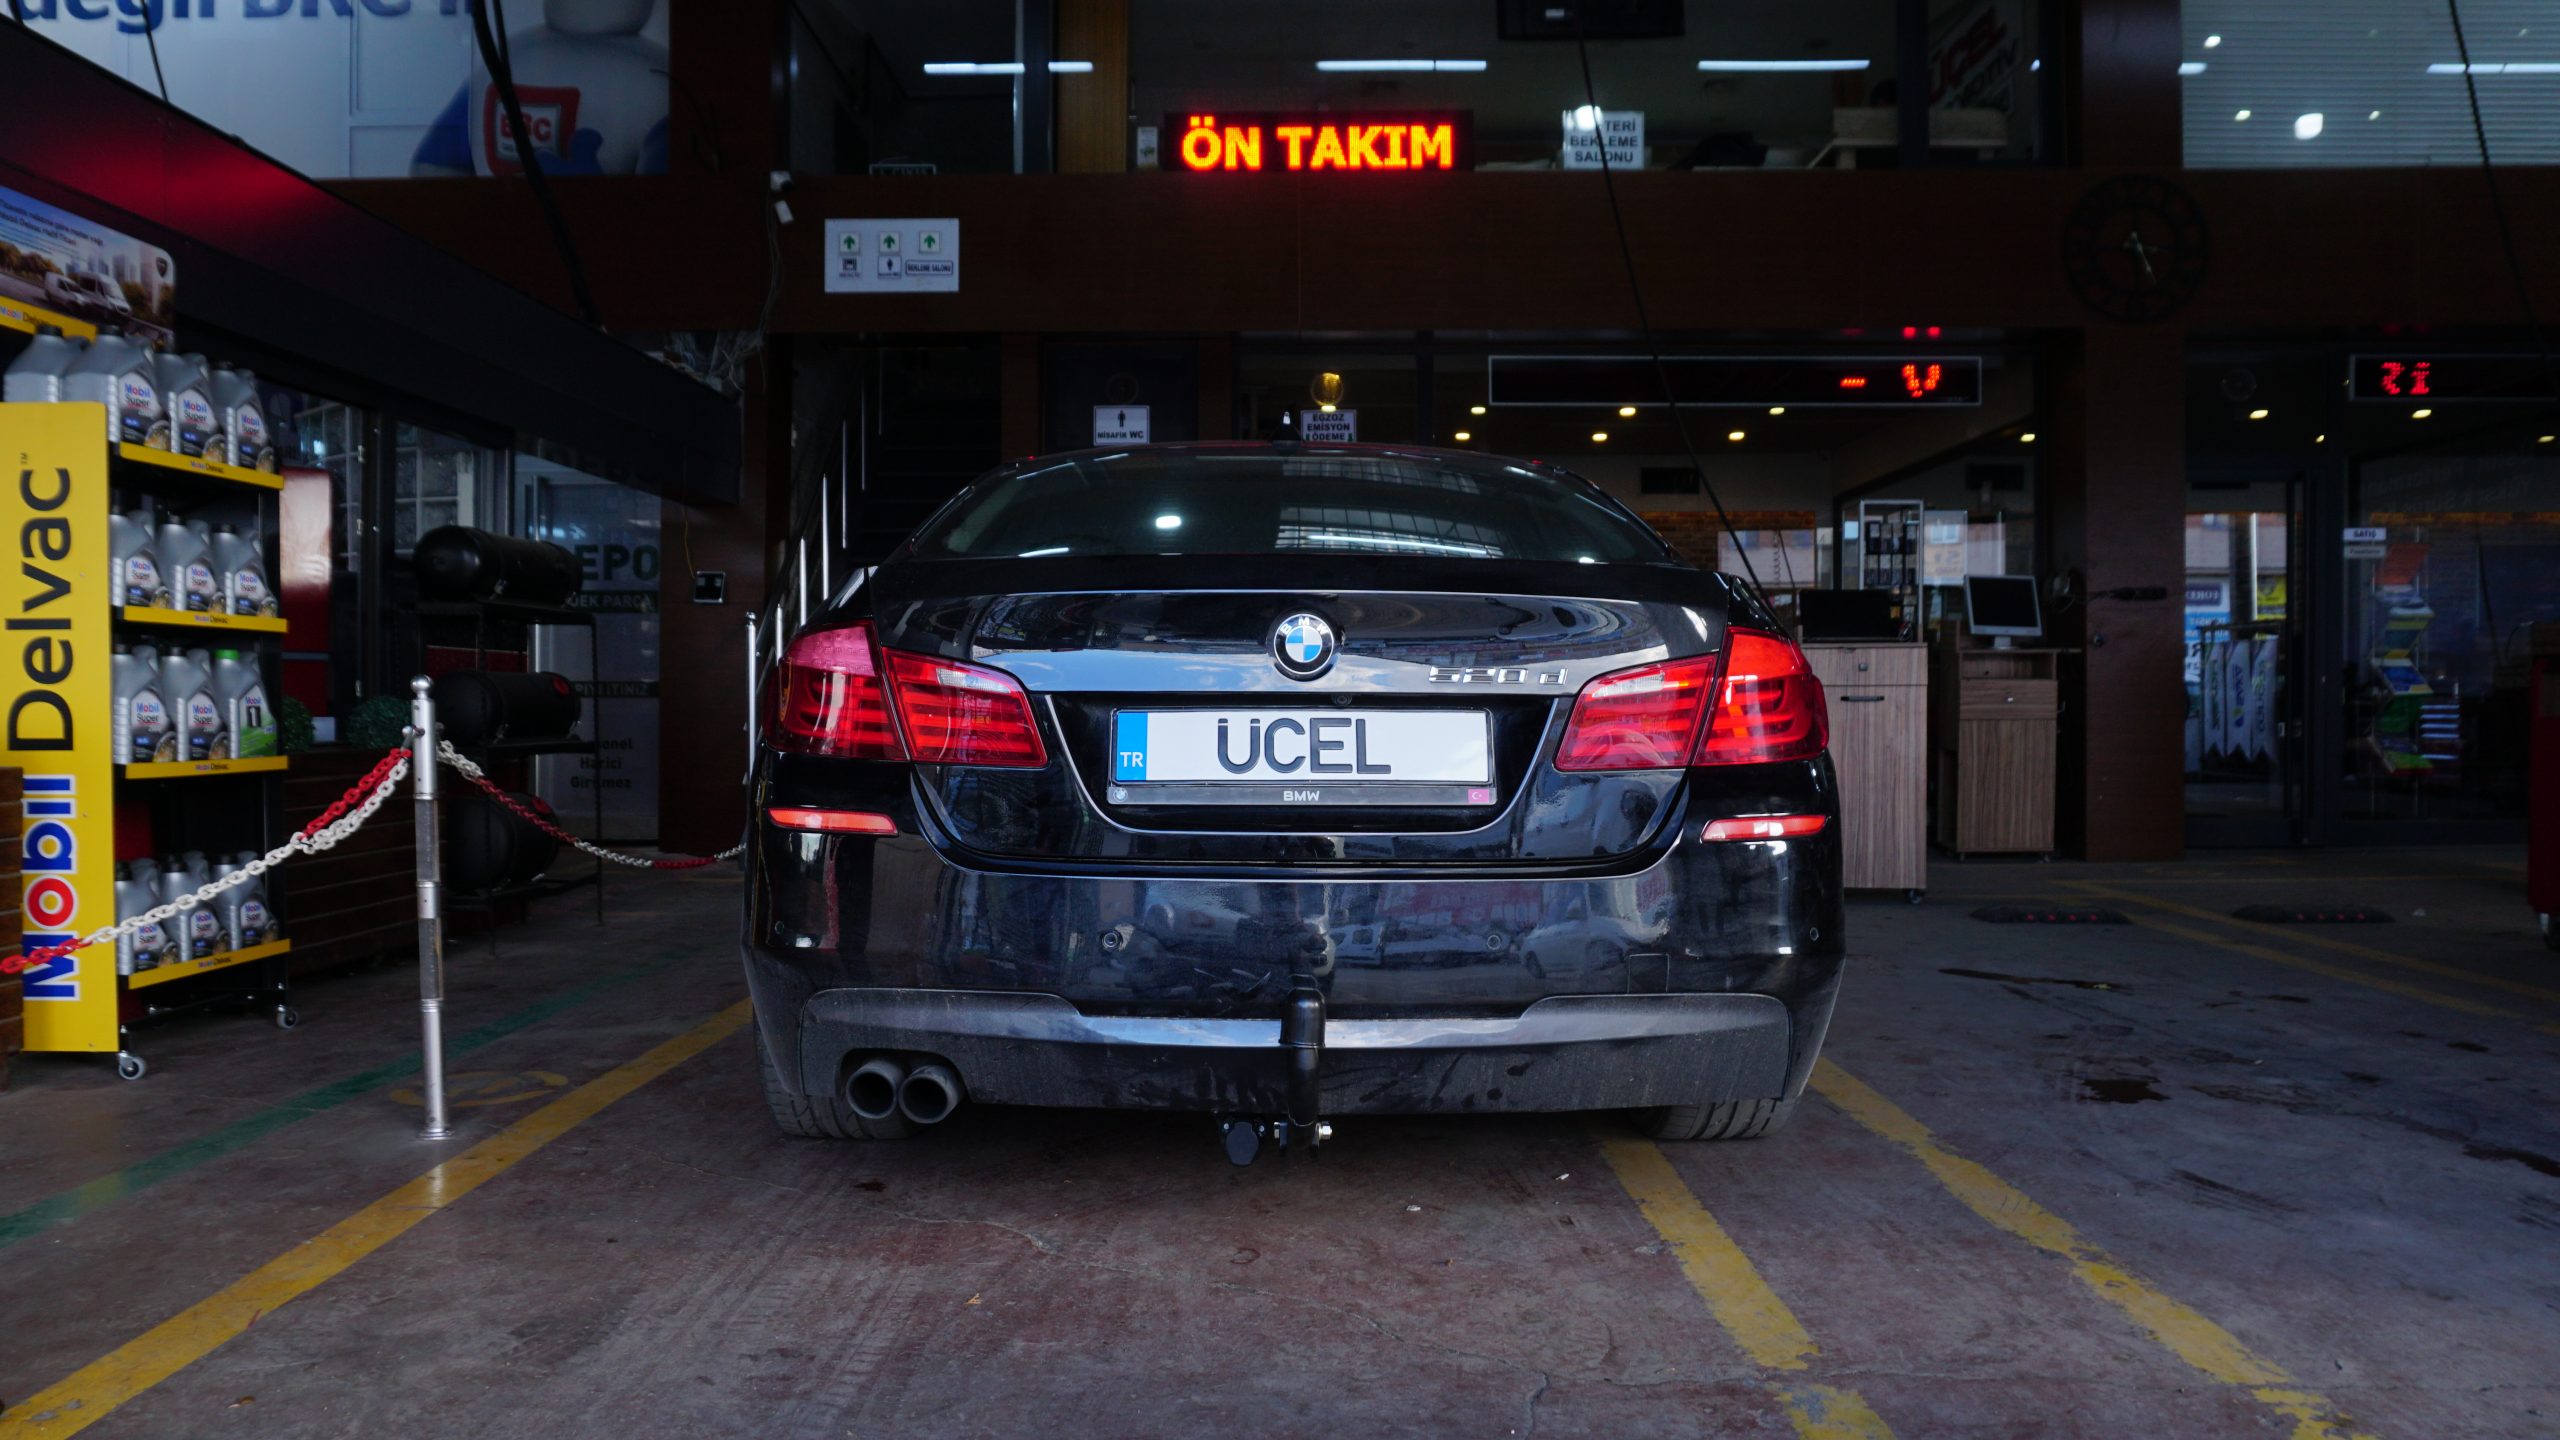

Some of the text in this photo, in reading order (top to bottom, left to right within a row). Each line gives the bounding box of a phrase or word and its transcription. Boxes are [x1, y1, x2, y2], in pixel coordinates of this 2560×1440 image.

[1182, 116, 1452, 169] ÖN TAKIM
[1575, 151, 1633, 162] SALONU
[1130, 430, 1144, 438] WC
[573, 544, 659, 580] EPO
[5, 467, 73, 751] Delvac
[1280, 616, 1330, 635] BMW
[136, 702, 160, 713] Mobil
[192, 704, 213, 715] Mobil
[1120, 752, 1143, 767] TR
[570, 775, 632, 789] Girmez
[1283, 790, 1320, 802] BMW
[22, 773, 80, 1001] Mobil
